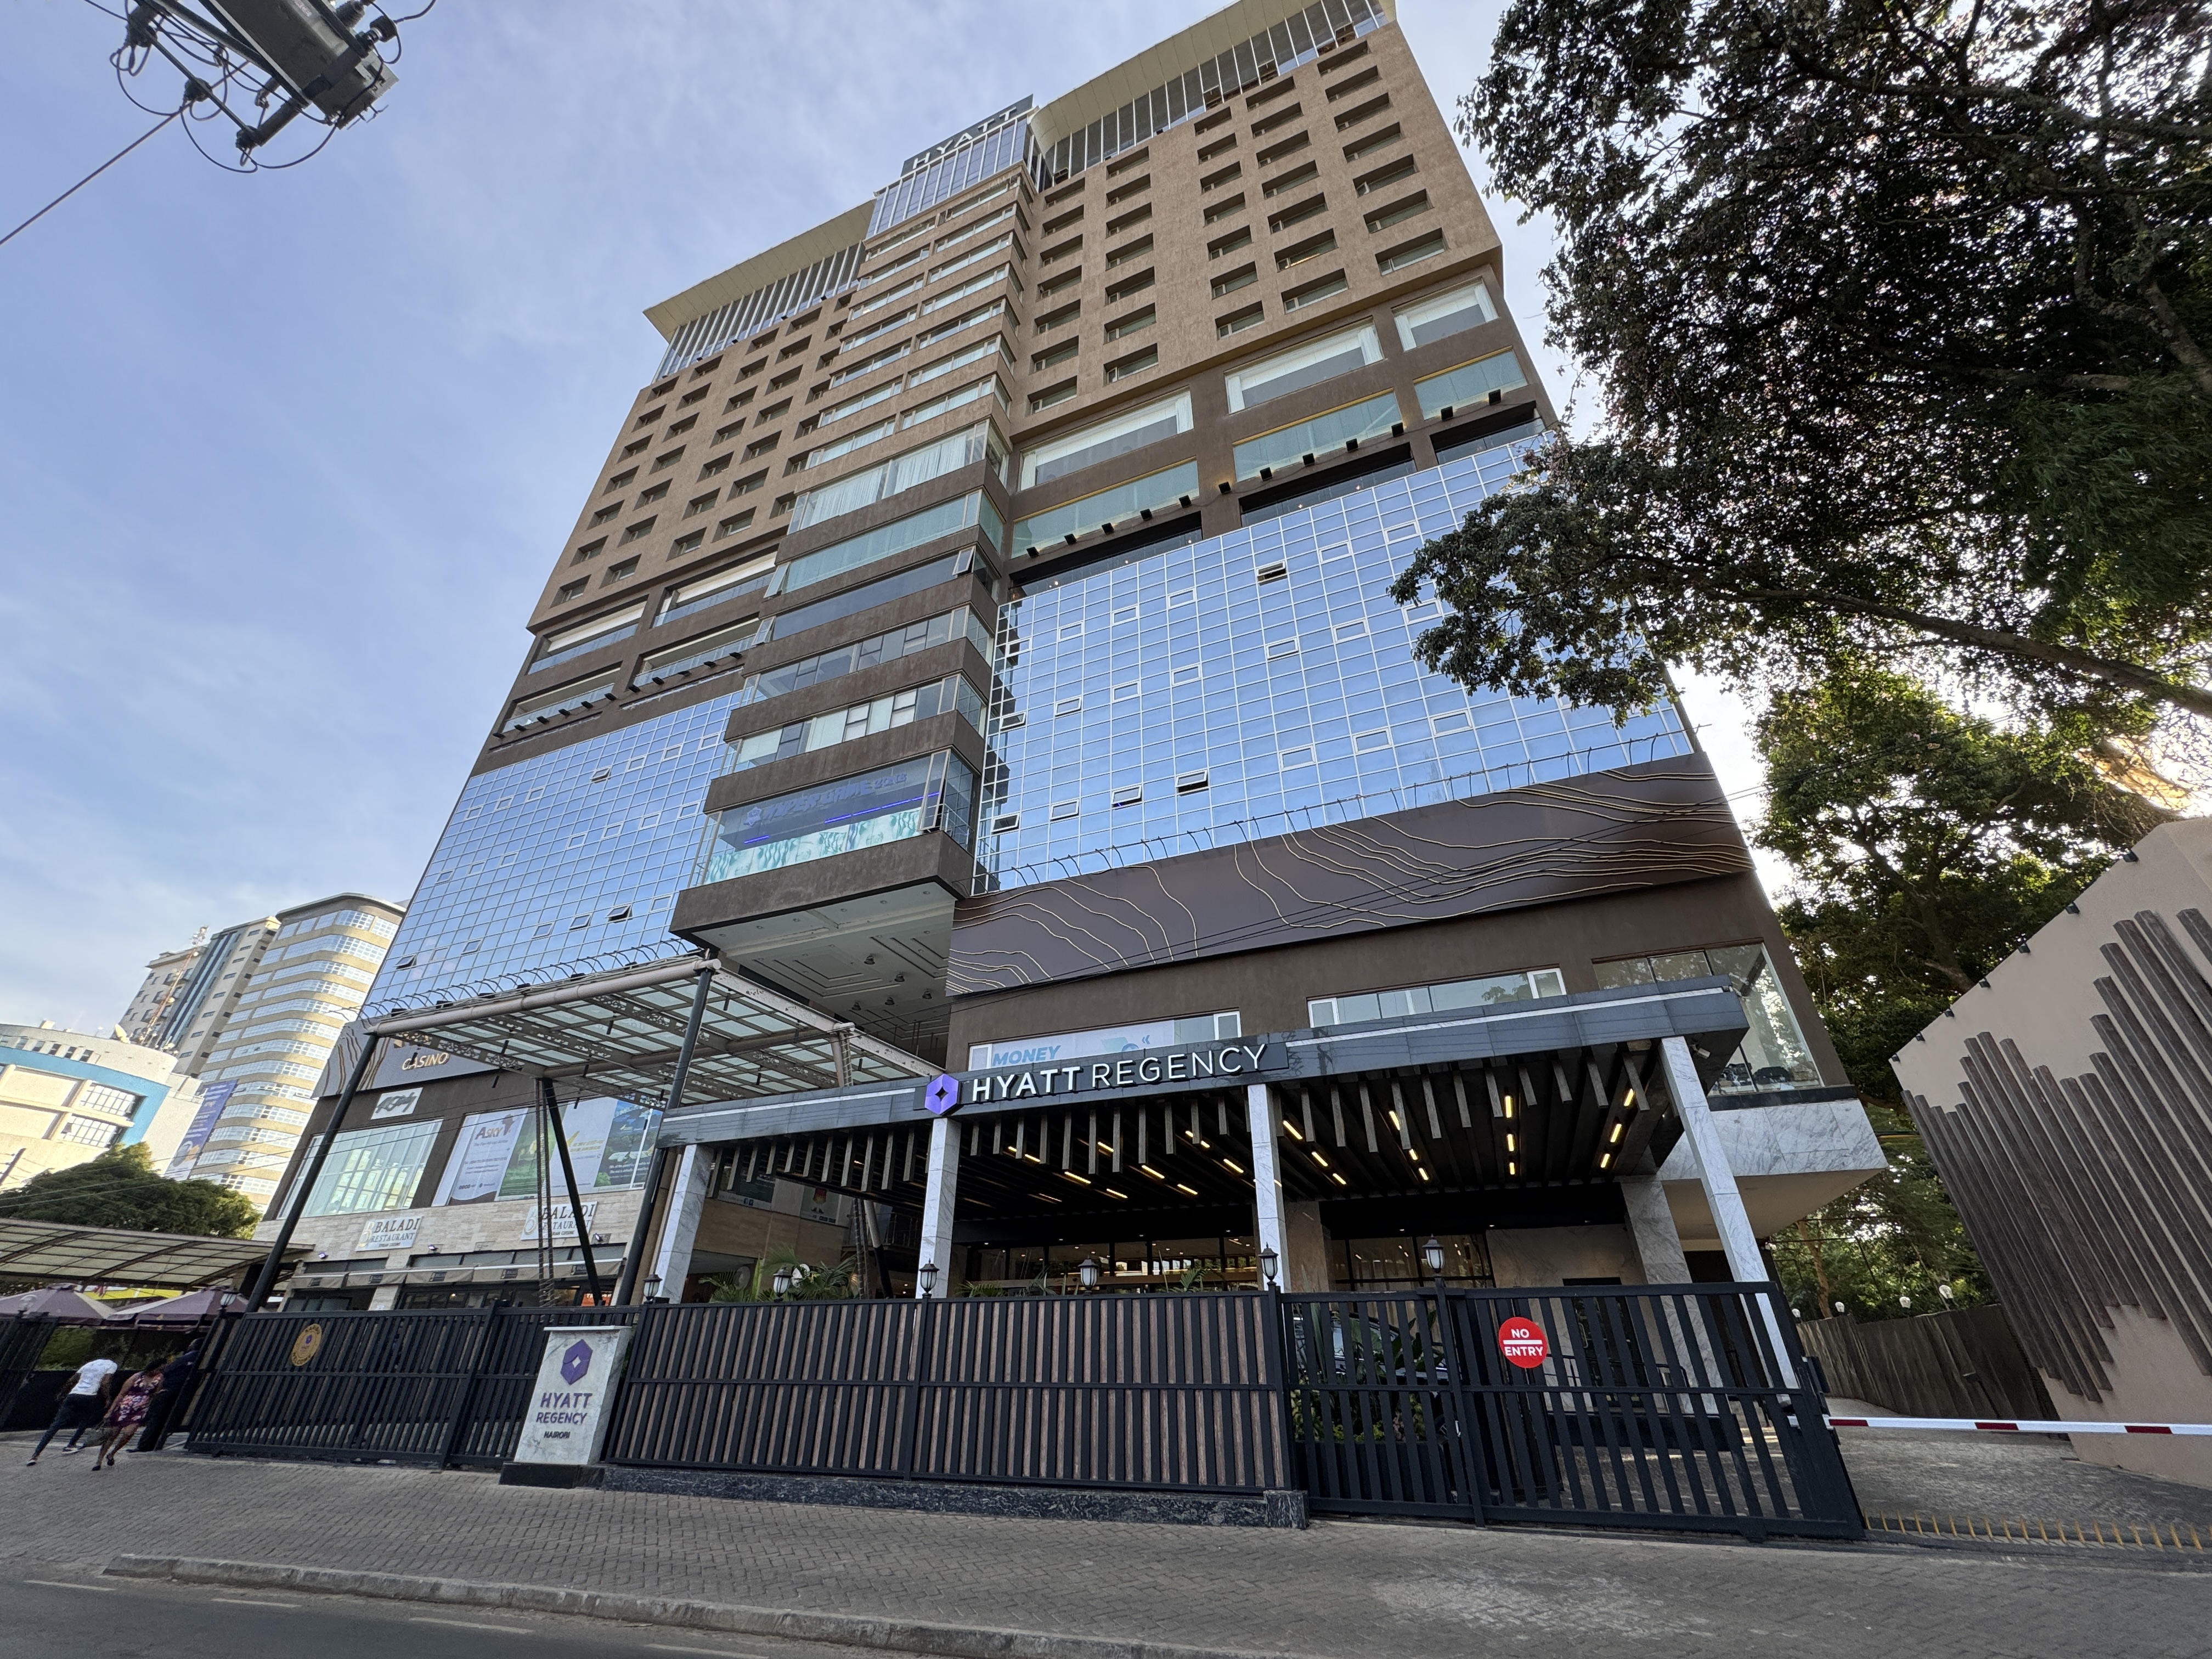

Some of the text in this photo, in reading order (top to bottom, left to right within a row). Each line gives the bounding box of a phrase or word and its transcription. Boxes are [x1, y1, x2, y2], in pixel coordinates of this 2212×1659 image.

[912, 106, 1017, 170] HYATT
[402, 1052, 449, 1070] CASINO
[992, 1045, 1060, 1066] MONEY
[972, 1043, 1267, 1102] HYATT REGENCY
[375, 1218, 420, 1232] BALADI
[371, 1233, 414, 1242] RESTAURANT
[1510, 1328, 1530, 1338] NO
[1504, 1346, 1543, 1357] ENTRY
[540, 1392, 593, 1408] HYATT
[535, 1412, 588, 1425] REGENCY
[544, 1431, 571, 1439] NAIROBI
